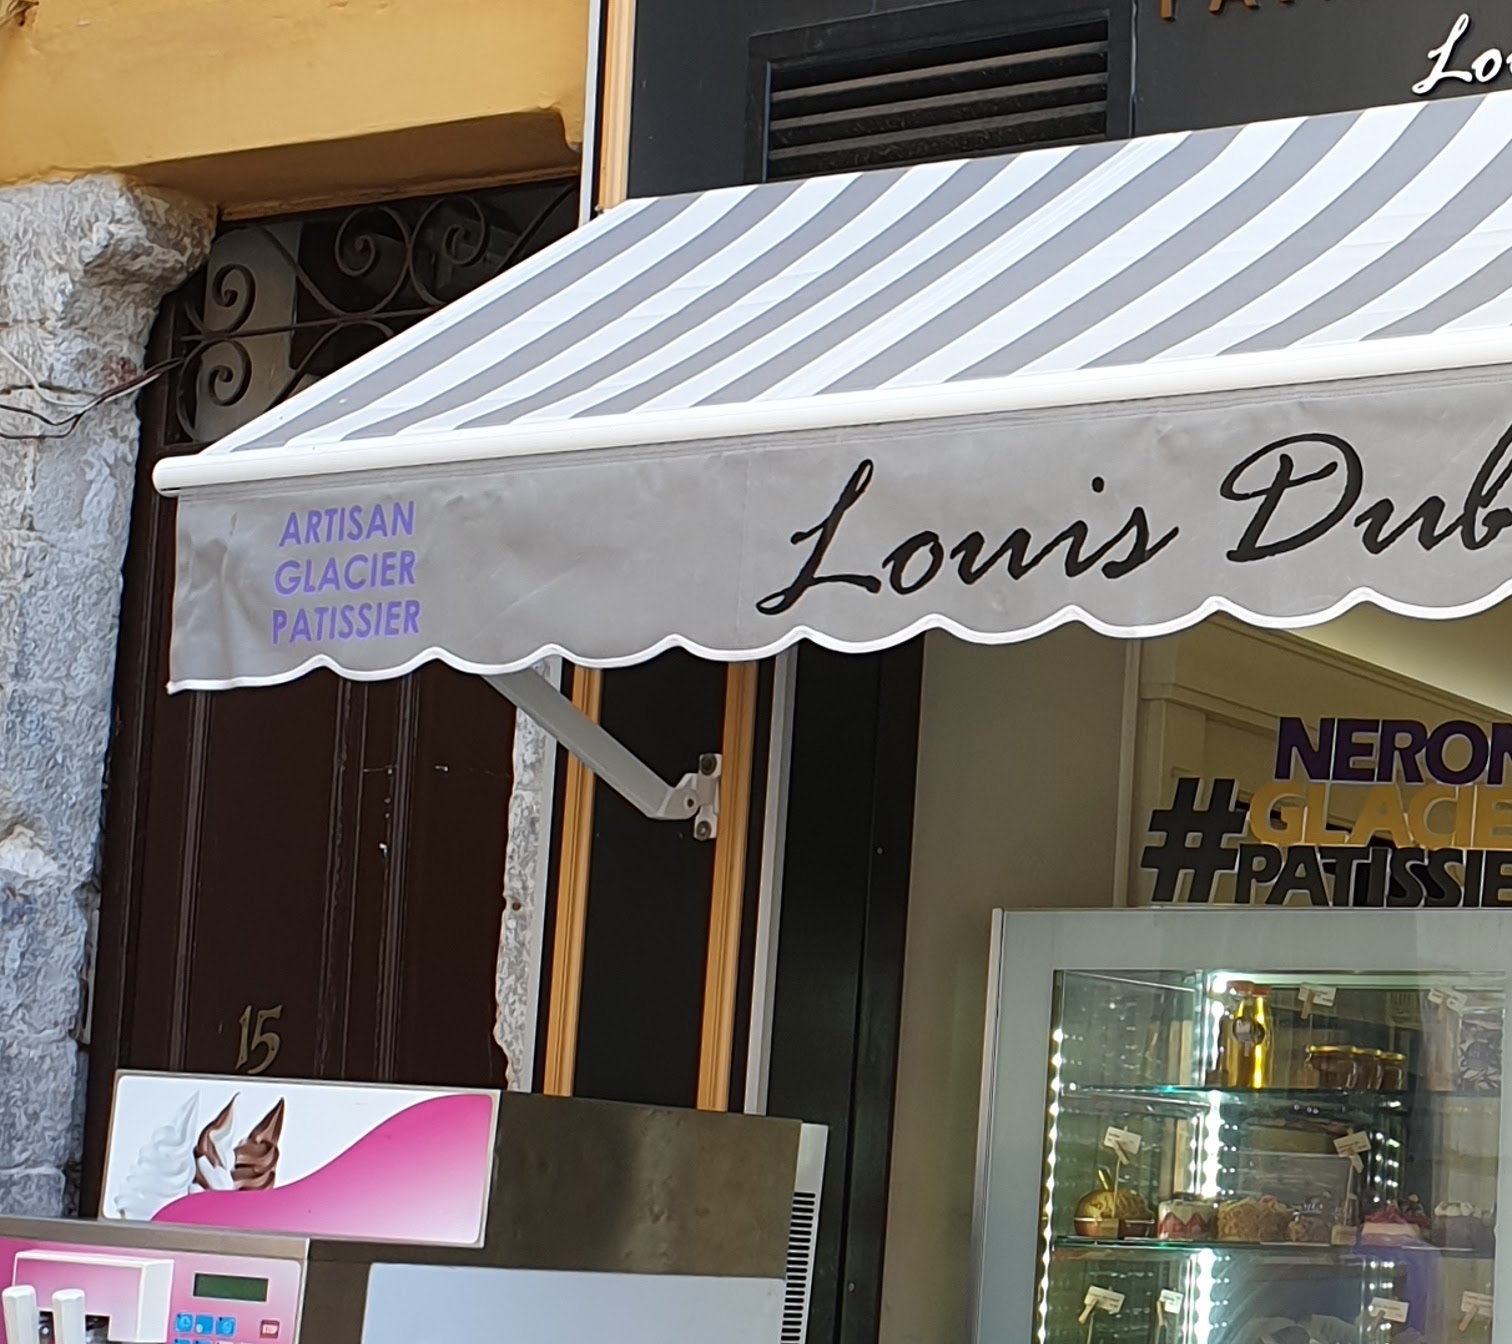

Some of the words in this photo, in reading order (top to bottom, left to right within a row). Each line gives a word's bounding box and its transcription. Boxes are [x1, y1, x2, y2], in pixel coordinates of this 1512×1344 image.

[278, 500, 415, 548] ARTISAN
[756, 459, 1180, 616] Louis
[274, 550, 417, 596] GLACIER
[271, 600, 421, 645] PATISSIER
[235, 1004, 283, 1074] 15
